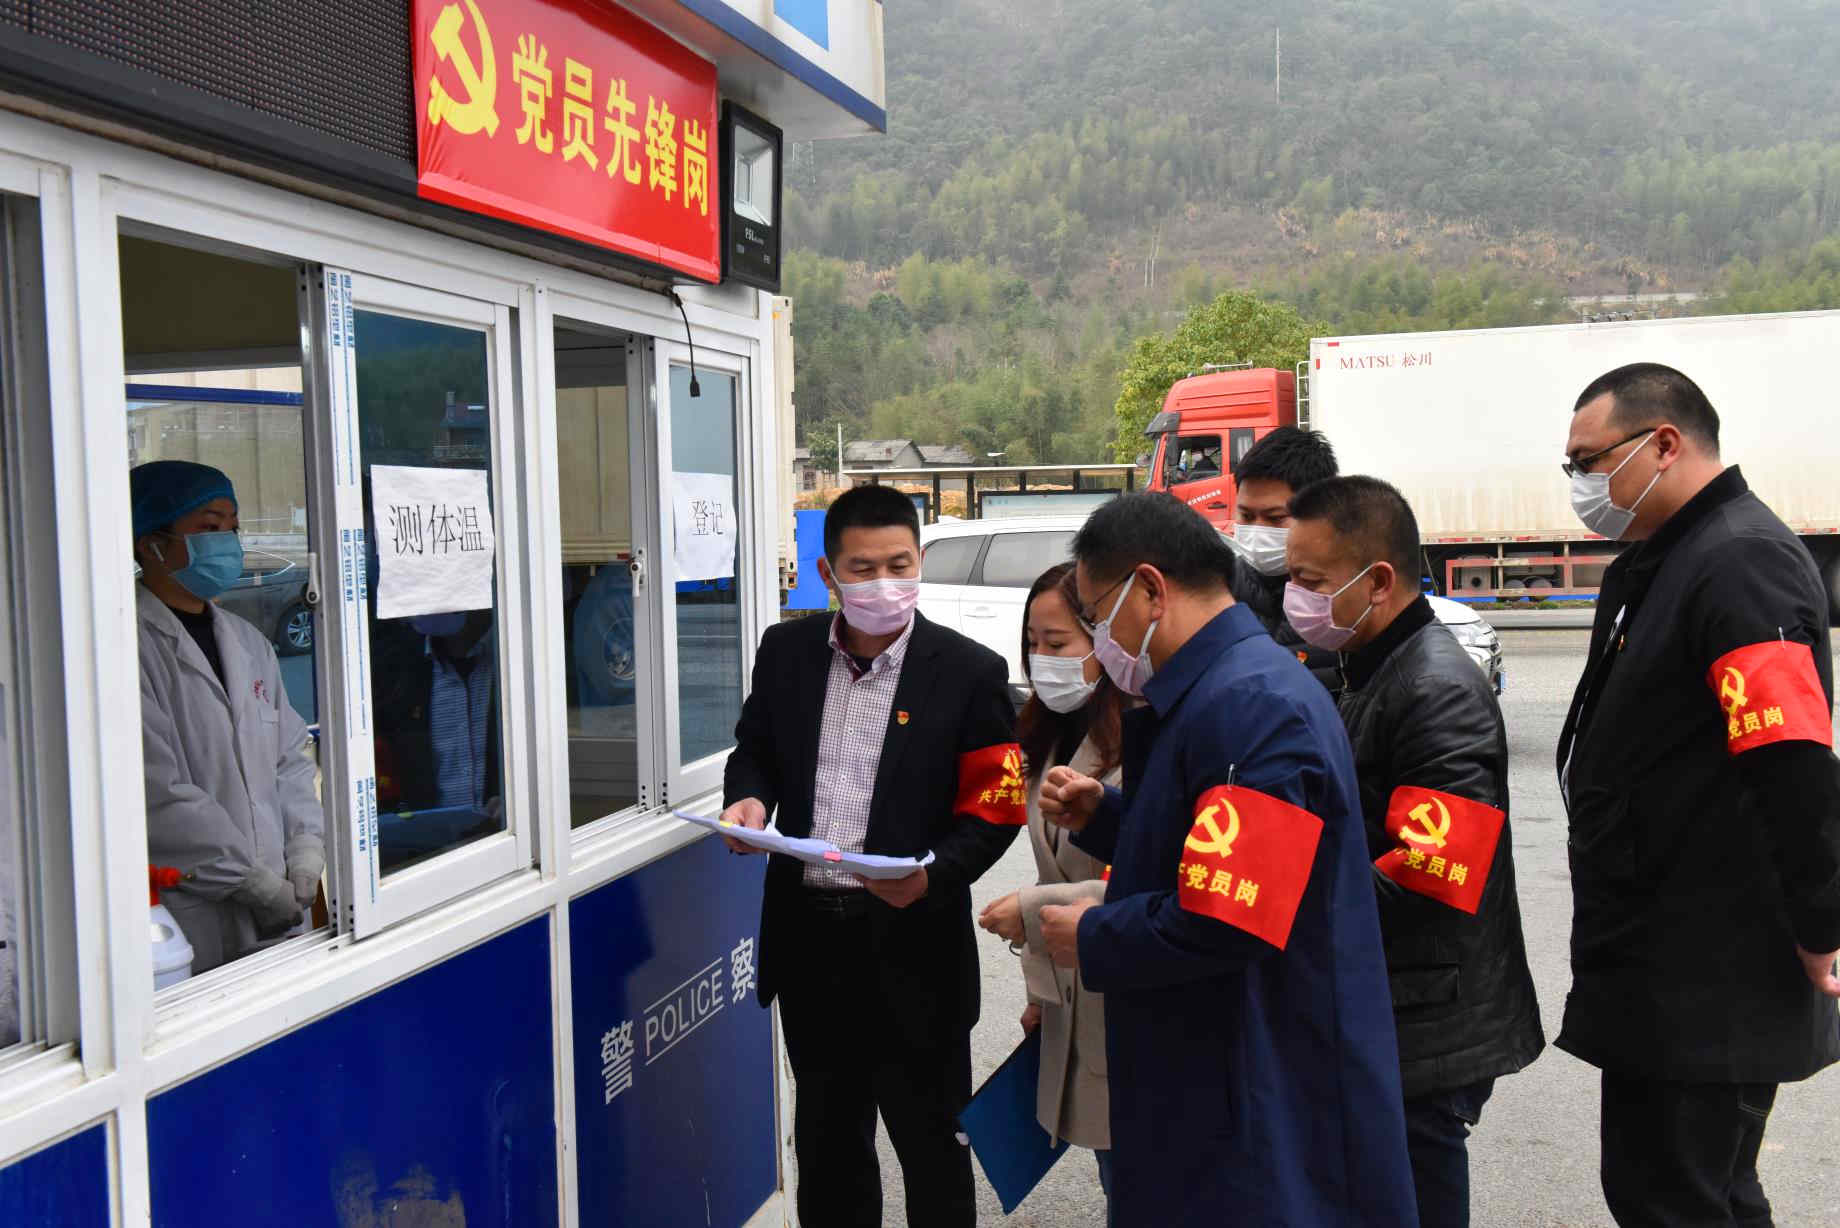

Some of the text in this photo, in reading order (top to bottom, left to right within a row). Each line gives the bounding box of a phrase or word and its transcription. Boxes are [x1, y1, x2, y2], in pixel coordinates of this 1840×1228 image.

[512, 33, 708, 216] 党员先锋岗
[1340, 351, 1432, 369] MATSU 松川
[389, 503, 485, 555] 测体温
[692, 500, 724, 536] 登记
[979, 788, 1026, 804] 共产党
[1395, 847, 1468, 886] 党员岗
[601, 936, 755, 1105] 警 POLICE 察
